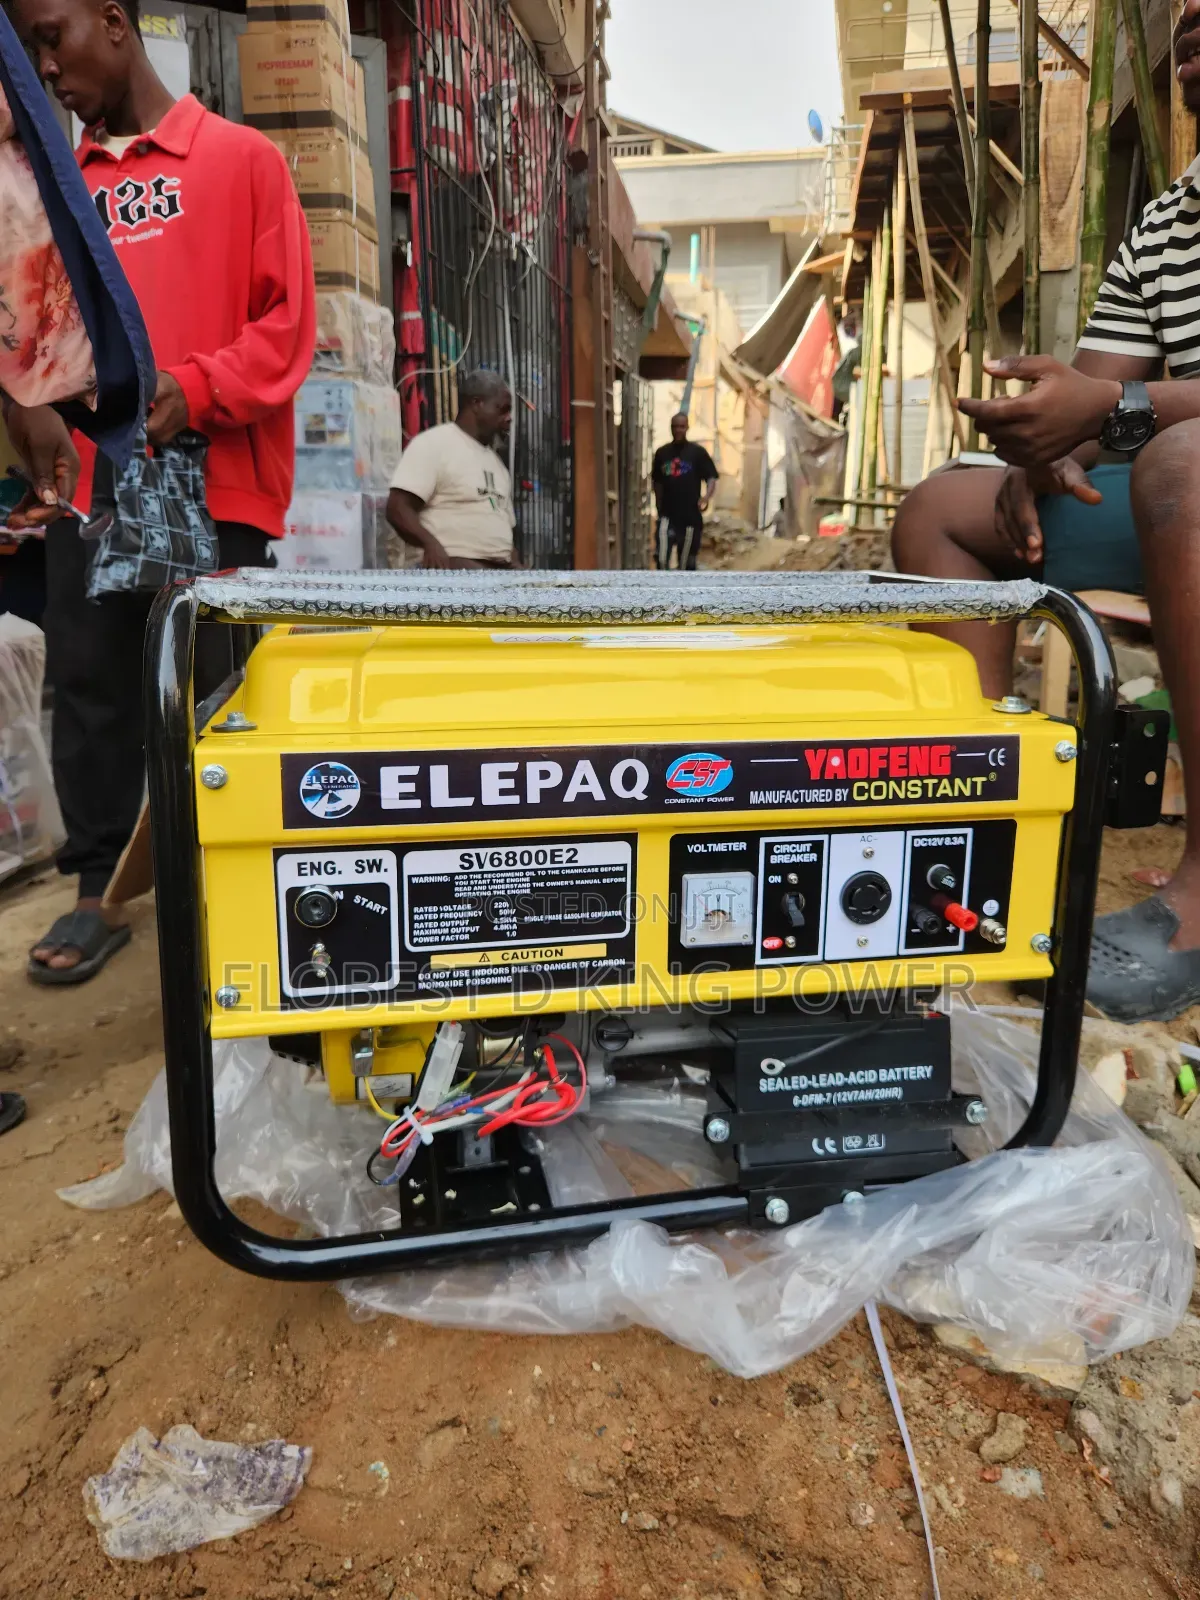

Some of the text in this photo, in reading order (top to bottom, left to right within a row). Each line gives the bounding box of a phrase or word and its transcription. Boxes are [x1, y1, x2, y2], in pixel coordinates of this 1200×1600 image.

[305, 775, 358, 784] ELEPAQ
[666, 759, 732, 790] CST
[380, 758, 650, 809] ELEPAQ
[749, 789, 831, 804] MANUFACTURED
[831, 788, 849, 802] BY
[687, 842, 747, 853] VOLTMETER
[773, 843, 812, 854] CIRCUIT
[459, 847, 579, 870] SV6800E2
[770, 853, 818, 864] BREAKER
[297, 858, 388, 876] ENG. SW.
[411, 875, 451, 884] WARNING:
[483, 871, 524, 879] RECOMMEND
[768, 875, 782, 883] ON
[454, 890, 492, 898] OPERATING
[353, 894, 388, 915] START
[439, 911, 483, 919] FREQUENCY
[563, 912, 590, 920] GASOLINE
[590, 909, 622, 918] GENERATOR
[413, 928, 449, 936] MAXIMUM
[450, 926, 480, 934] OUTPUT
[413, 935, 439, 943] POWER
[440, 934, 470, 942] FACTOR
[763, 939, 780, 948] OFF
[501, 948, 564, 961] CAUTION
[432, 971, 451, 980] NOT
[453, 969, 470, 977] USE
[472, 967, 509, 976] INDOORS
[511, 966, 528, 974] DUE
[531, 964, 542, 972] TO
[543, 961, 578, 971] DANGER
[579, 960, 590, 968] OF
[592, 958, 625, 967] CARBON
[418, 976, 513, 990] MONOXIDE POISONING
[759, 1065, 934, 1093] SEALED-LEAD-ACID BATTERY
[792, 1086, 903, 1107] 6-DFM-7 (12V7AH/20HR)
